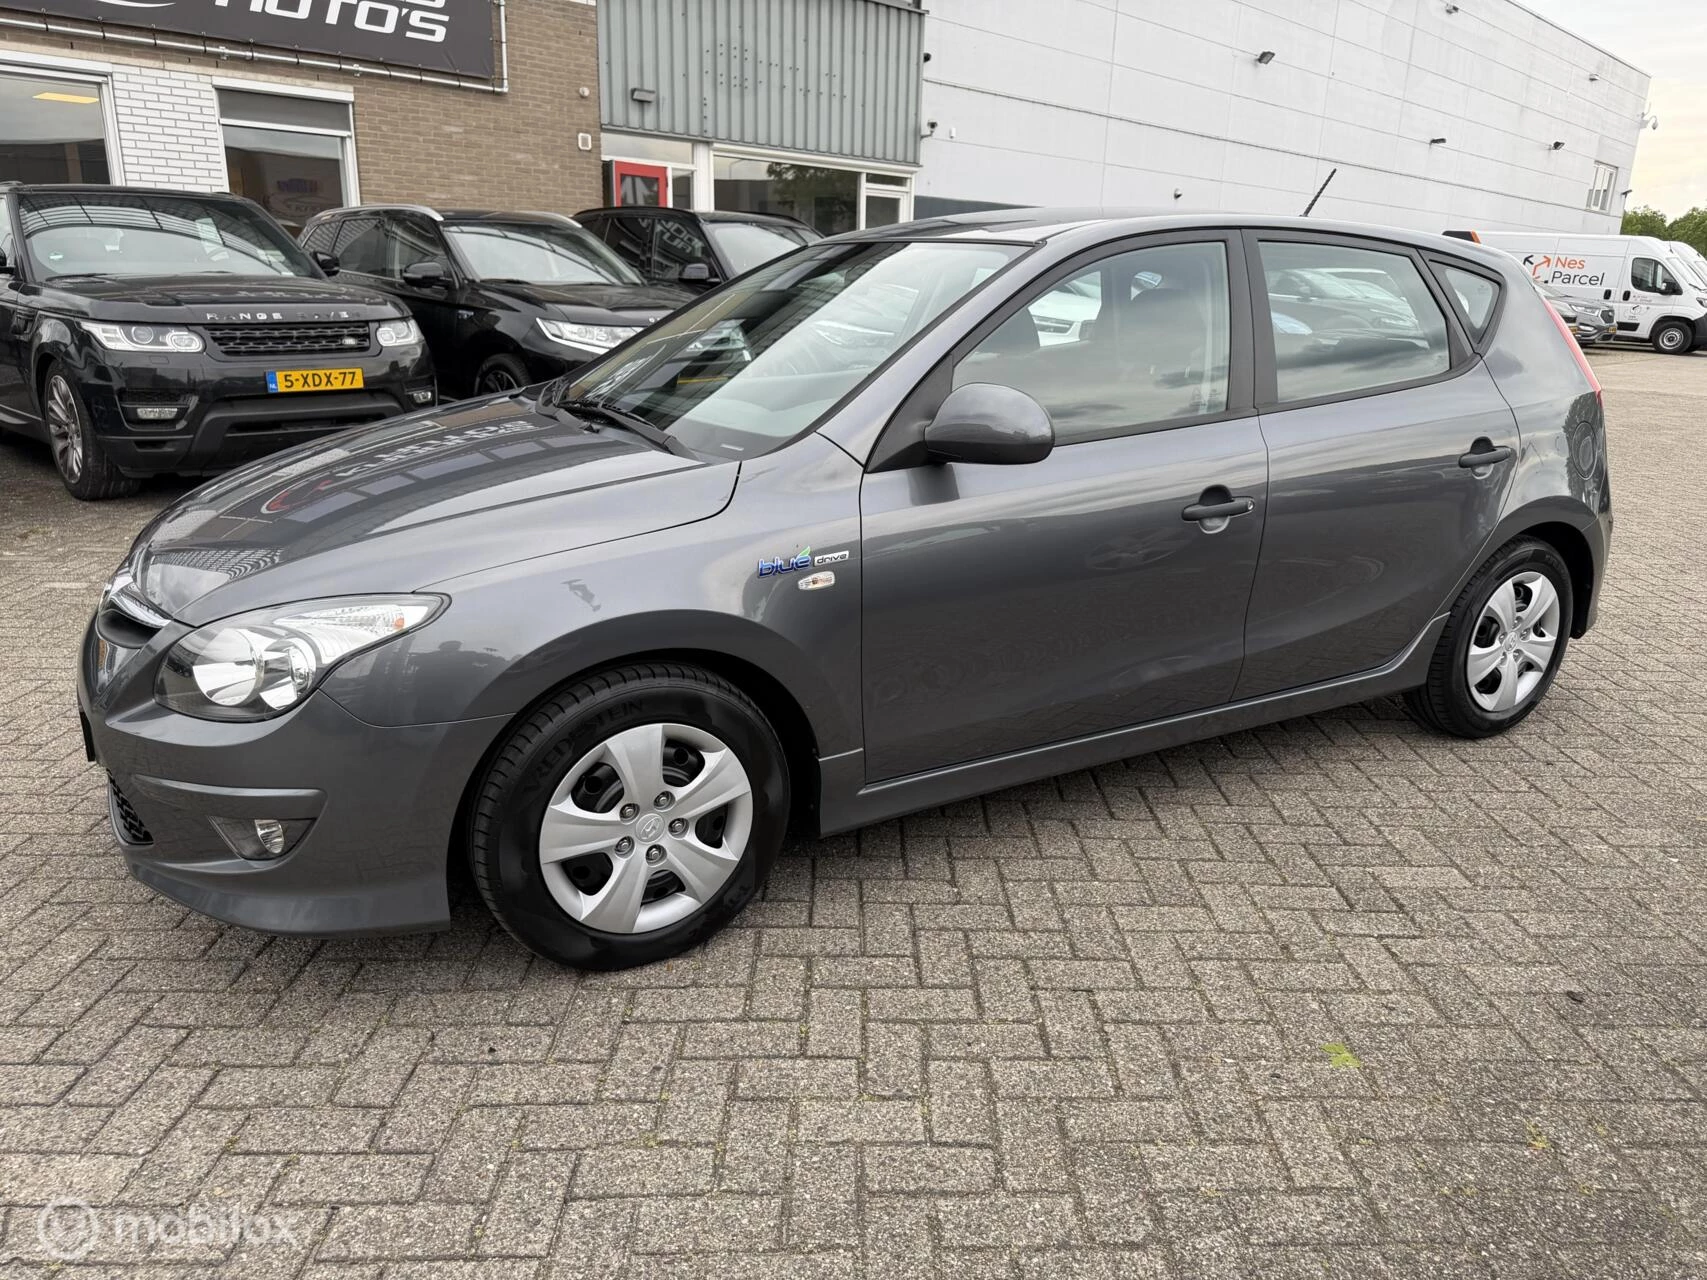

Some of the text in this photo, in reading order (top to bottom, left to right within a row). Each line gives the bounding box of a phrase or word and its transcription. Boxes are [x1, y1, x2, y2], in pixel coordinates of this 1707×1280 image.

[1554, 255, 1586, 270] Nes
[1550, 270, 1605, 286] Parcel
[283, 371, 357, 389] 5-XDX-77
[816, 552, 848, 565] drive
